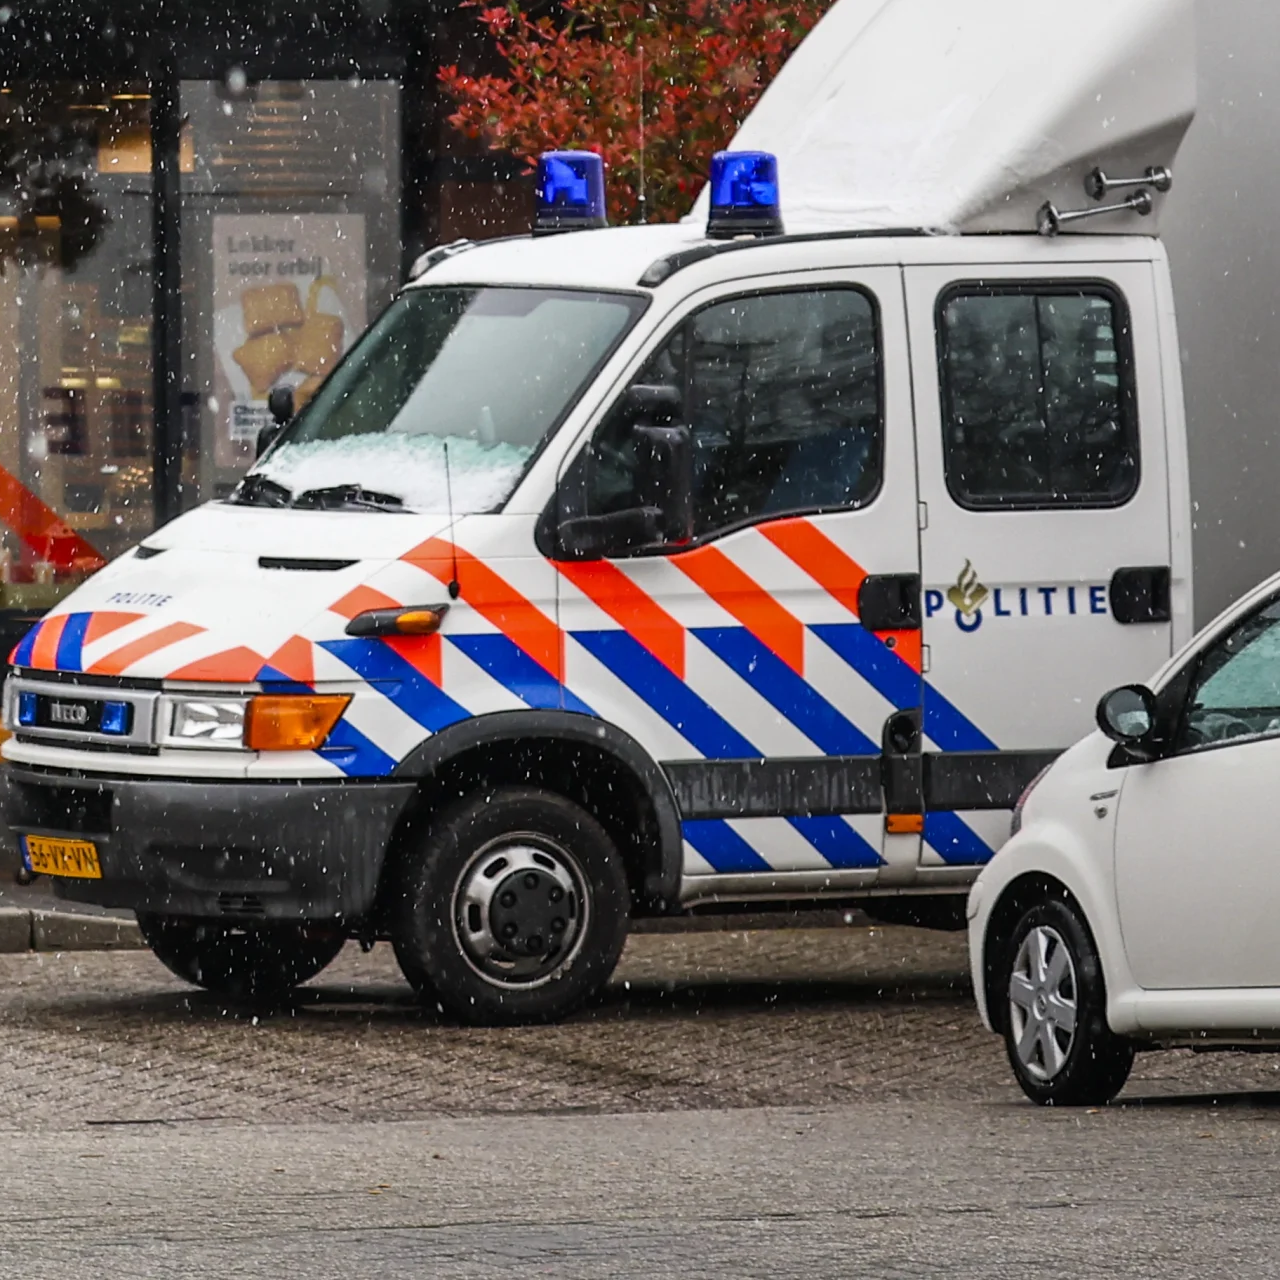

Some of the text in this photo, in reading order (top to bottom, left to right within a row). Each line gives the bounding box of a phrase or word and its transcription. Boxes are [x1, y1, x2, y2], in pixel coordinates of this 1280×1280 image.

[227, 235, 295, 253] Lekker
[228, 256, 322, 277] voor erbij
[105, 592, 173, 607] POLITIE
[925, 585, 1107, 633] POLITIE
[51, 703, 88, 725] IVECO
[29, 841, 96, 872] 56-VX-VN
